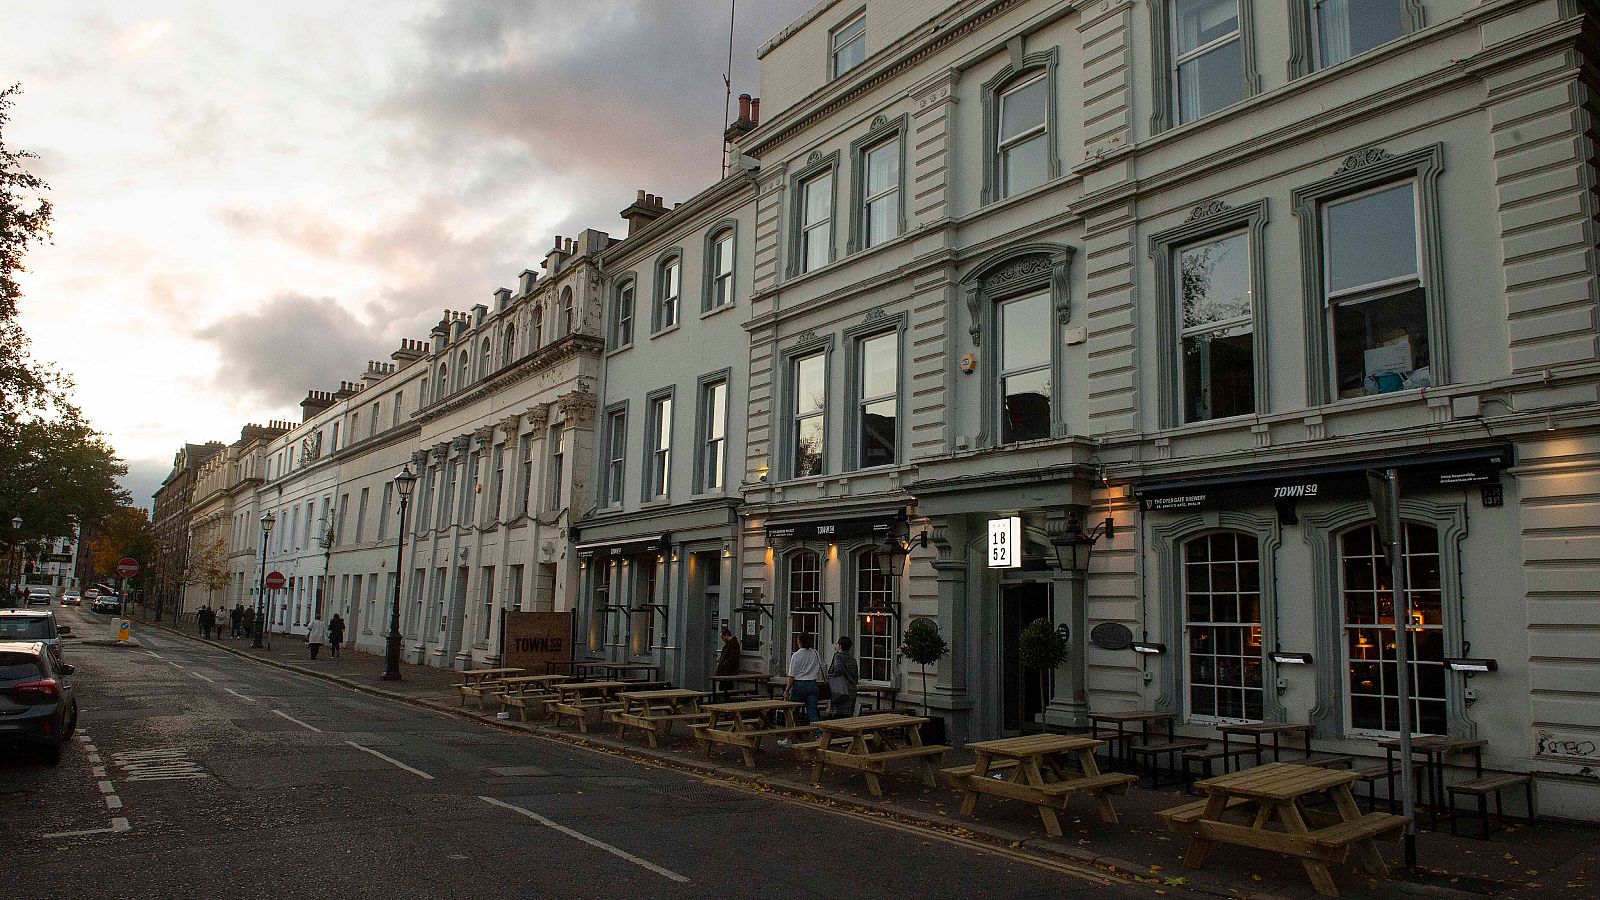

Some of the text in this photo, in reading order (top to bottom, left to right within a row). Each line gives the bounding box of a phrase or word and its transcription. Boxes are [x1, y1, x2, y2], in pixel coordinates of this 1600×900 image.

[1273, 484, 1318, 497] TOWN SQ
[993, 531, 1006, 545] 18
[993, 547, 1006, 561] 52
[515, 637, 562, 652] TOWN SQ
